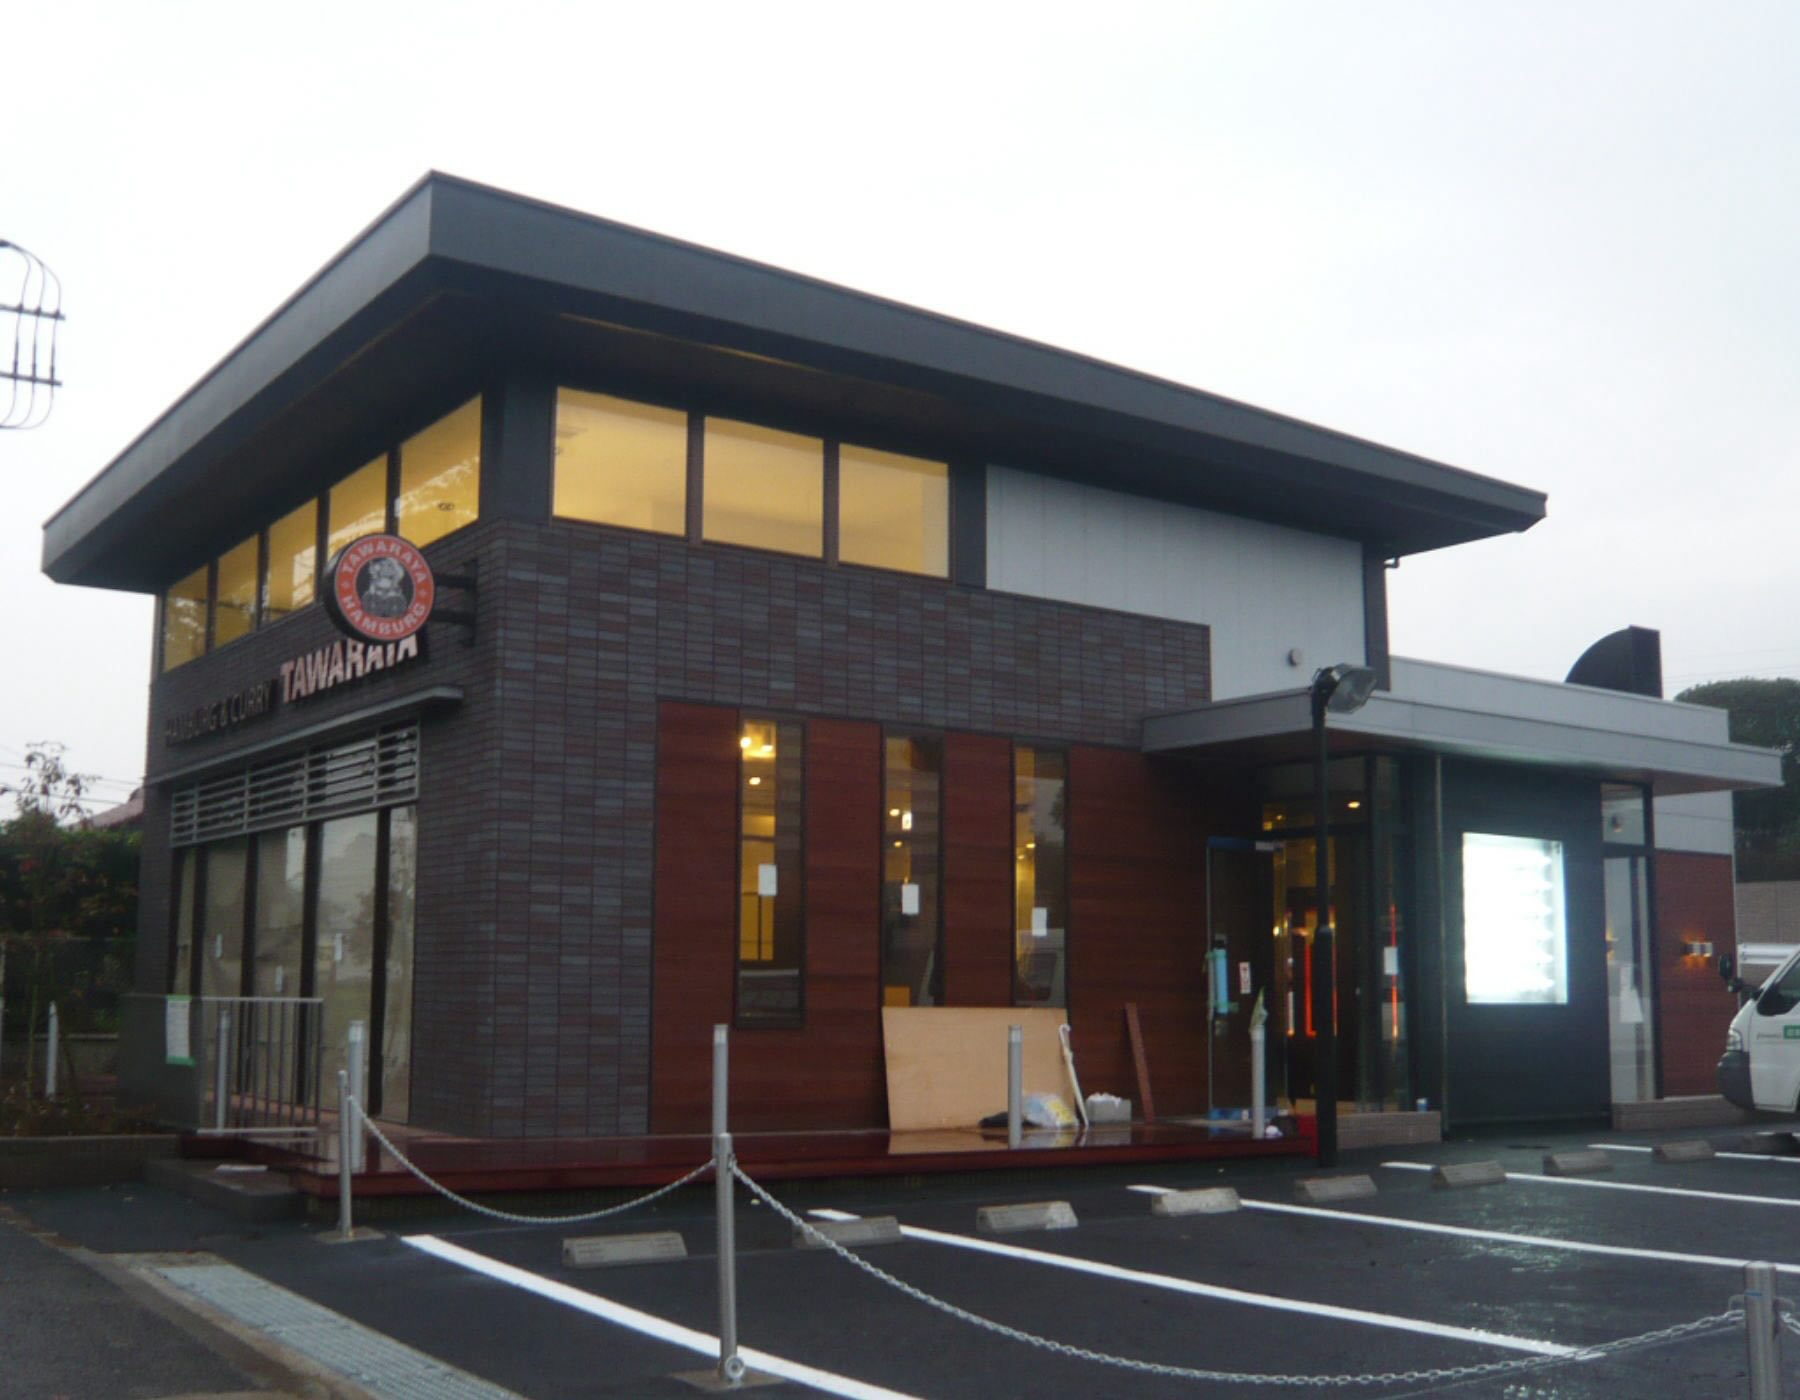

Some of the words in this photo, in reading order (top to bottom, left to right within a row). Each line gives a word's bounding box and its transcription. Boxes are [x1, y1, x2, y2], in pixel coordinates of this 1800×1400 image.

[342, 540, 427, 583] TAWARAYA
[342, 595, 426, 635] HAMBURG
[232, 681, 271, 721] CURRY
